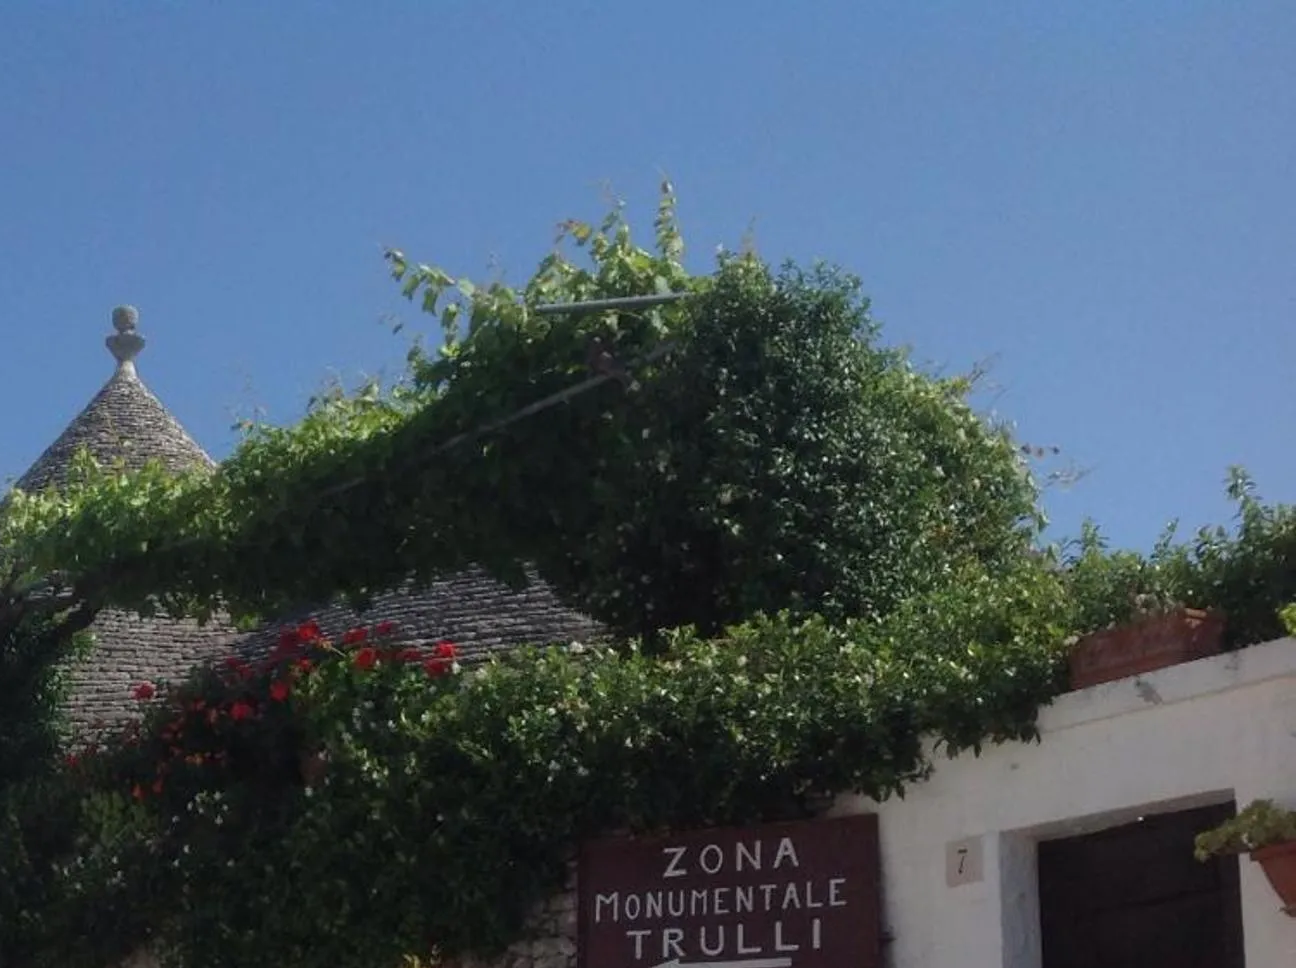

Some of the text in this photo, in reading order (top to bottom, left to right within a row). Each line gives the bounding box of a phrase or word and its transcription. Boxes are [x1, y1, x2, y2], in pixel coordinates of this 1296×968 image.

[663, 837, 799, 876] ZONA
[958, 849, 968, 874] 7
[595, 879, 847, 923] MONUMENTALE
[627, 919, 821, 959] TRULLI
